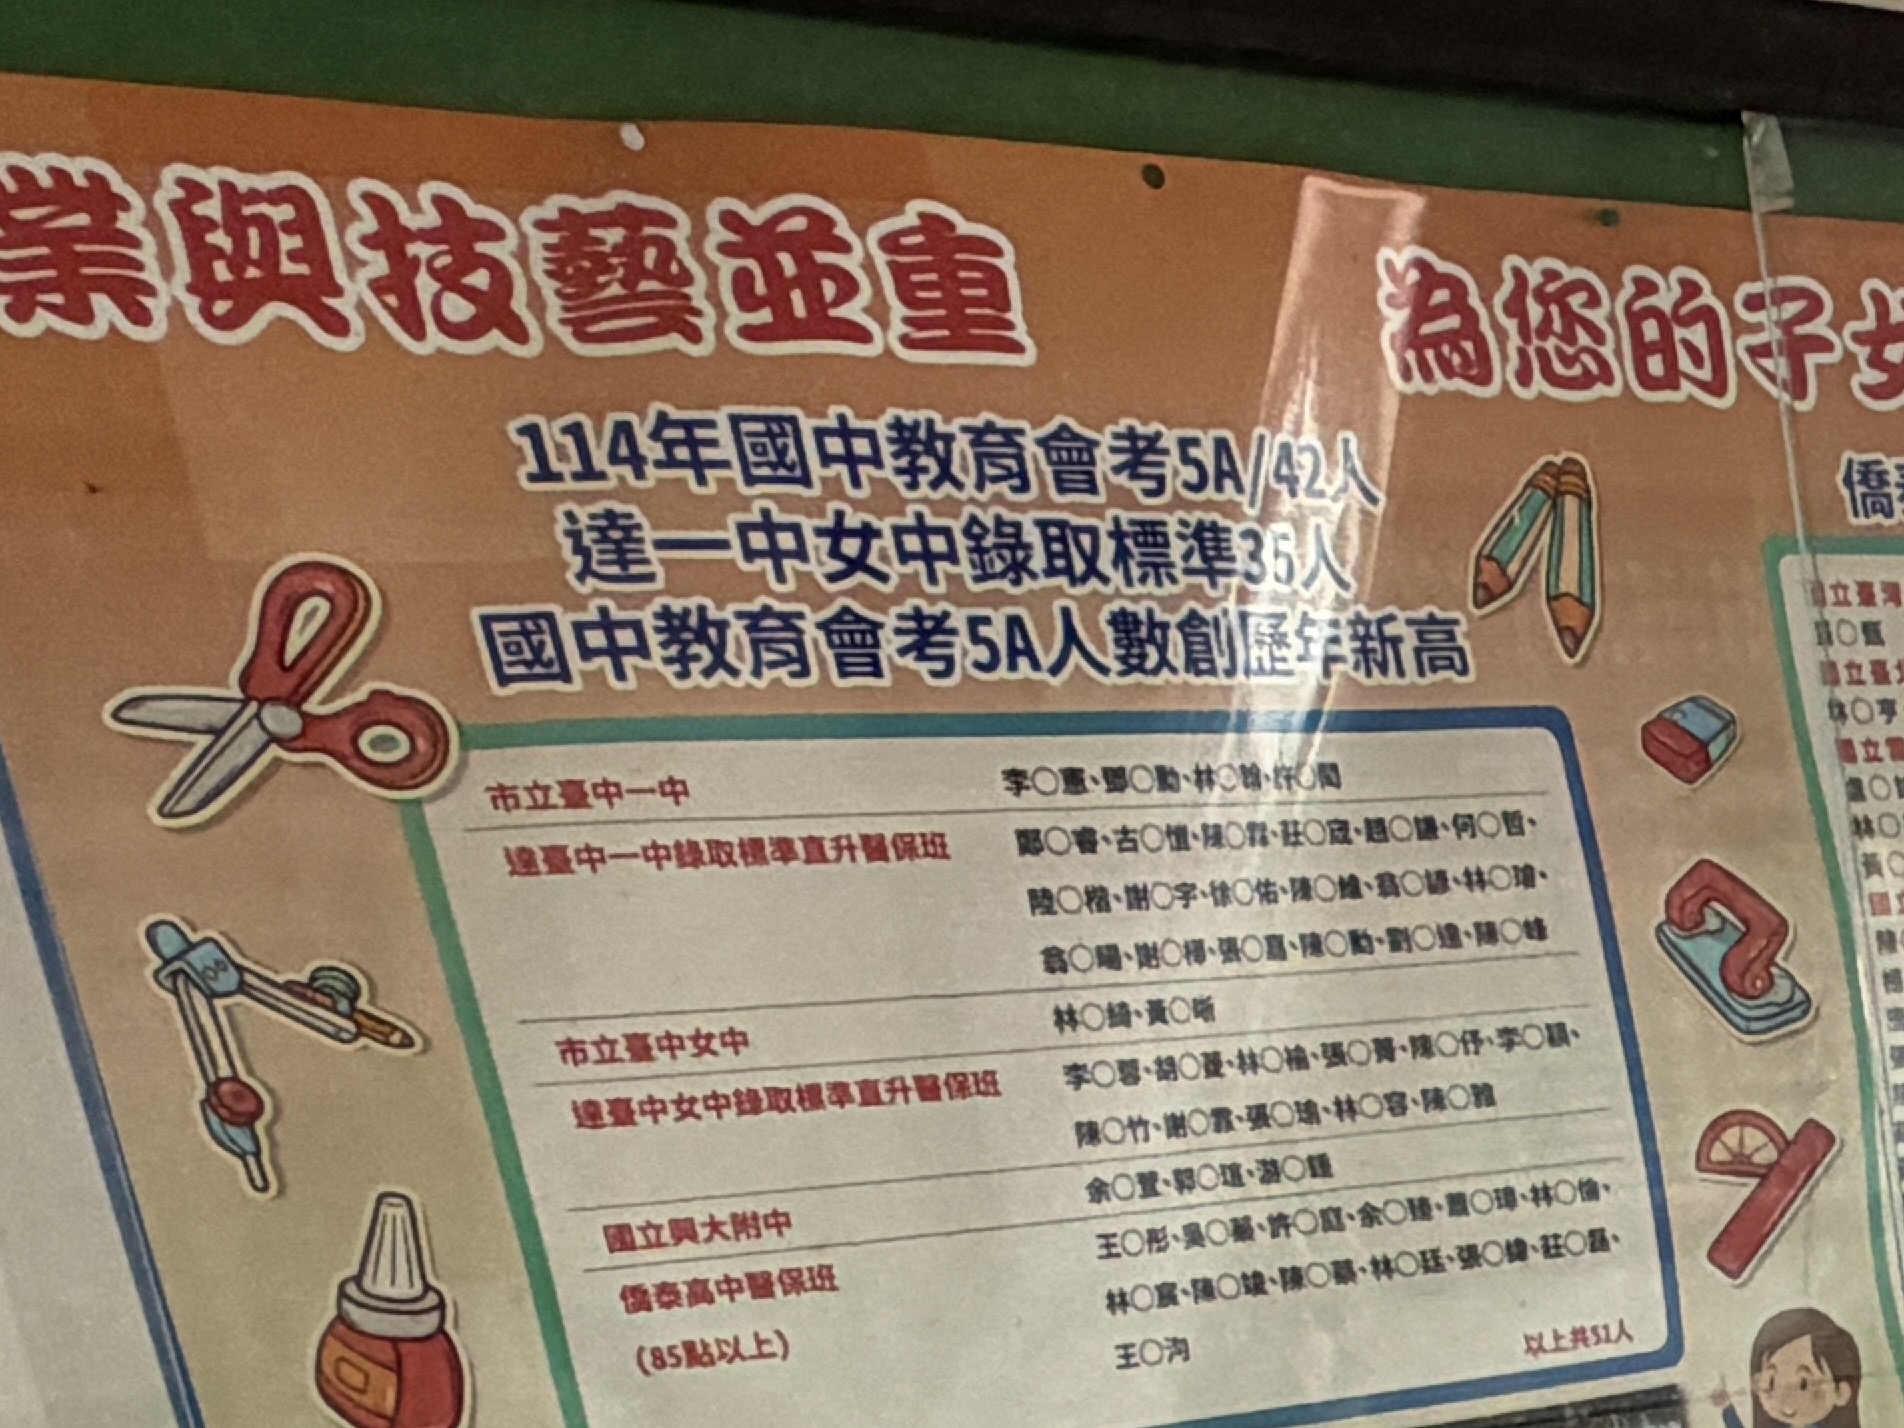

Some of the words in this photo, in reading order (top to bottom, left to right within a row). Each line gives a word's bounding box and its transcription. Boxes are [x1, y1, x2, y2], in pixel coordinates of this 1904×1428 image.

[0, 163, 1028, 356] 業與技藝並重
[518, 408, 1380, 510] 114年國中教育會考5A/42人
[563, 508, 1352, 594] 達一中女中錄取標準35人
[482, 606, 1467, 688] 國中教育會考5A人數創歷年新高
[485, 775, 690, 812] 市立臺中一中
[555, 1026, 750, 1067] 市立臺中女中
[602, 1207, 793, 1254] 國立興大附中
[619, 1263, 839, 1314] 僑泰高中醫保班
[636, 1329, 790, 1376] (85點以上)
[1524, 1318, 1634, 1358] 以上共51人
